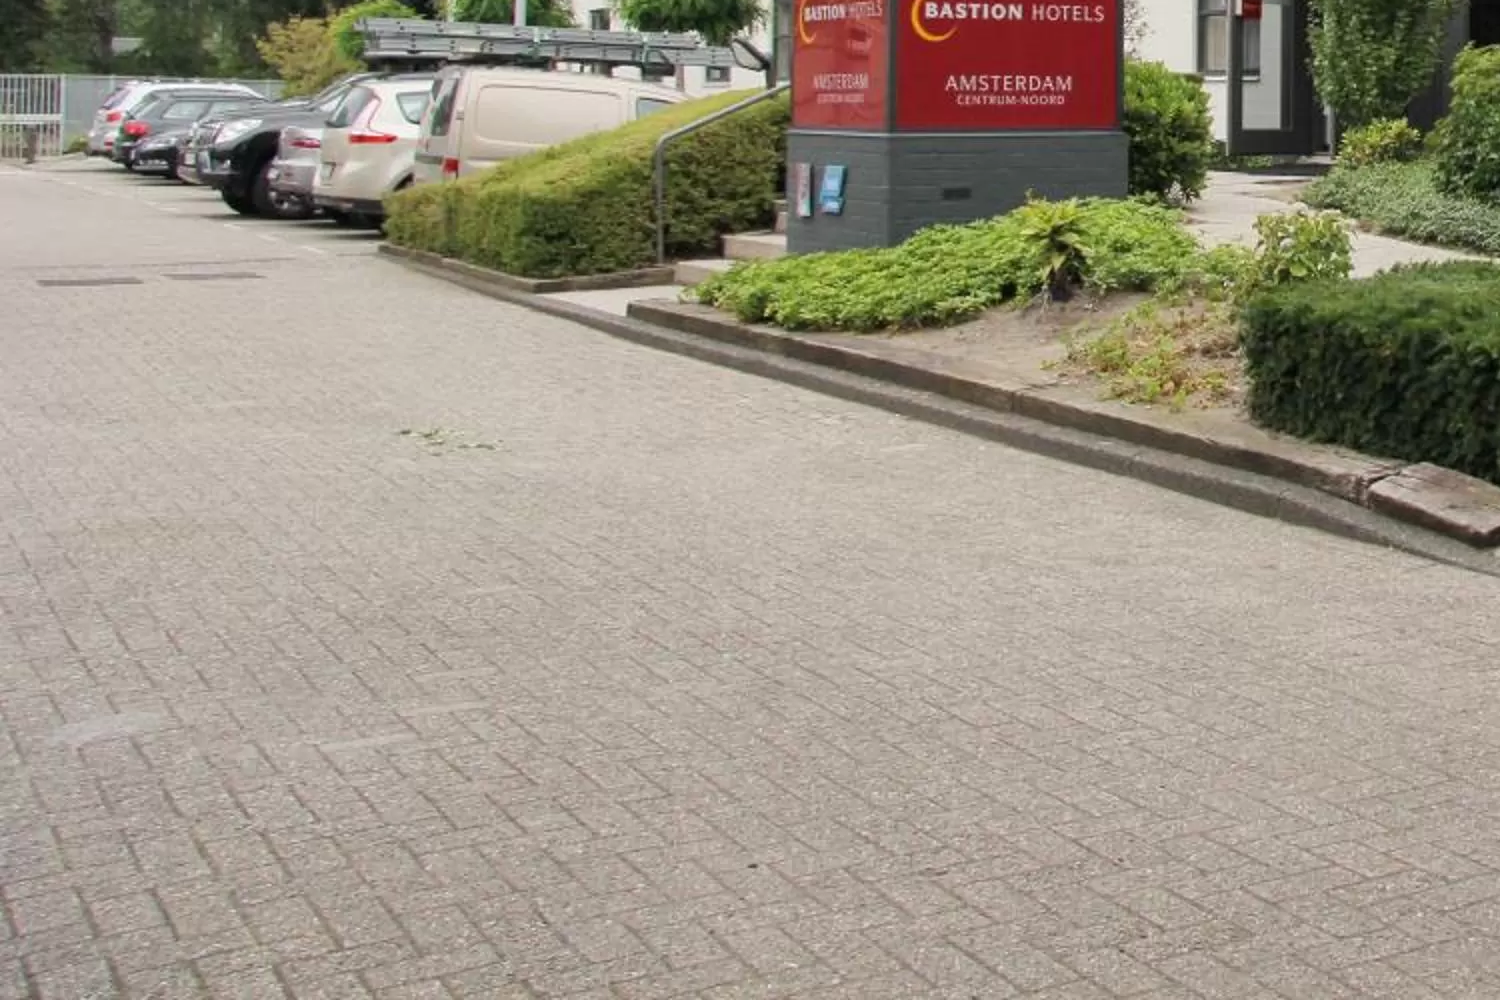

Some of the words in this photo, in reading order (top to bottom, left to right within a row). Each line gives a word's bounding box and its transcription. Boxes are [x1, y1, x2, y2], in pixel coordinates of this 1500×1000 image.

[803, 4, 845, 22] BASTION
[848, 0, 883, 20] HOTELS
[924, 2, 1023, 21] BASTION
[1031, 4, 1105, 23] HOTELS
[945, 75, 1073, 92] AMSTERDAM
[956, 94, 1065, 105] CENTRUM-NOORD
